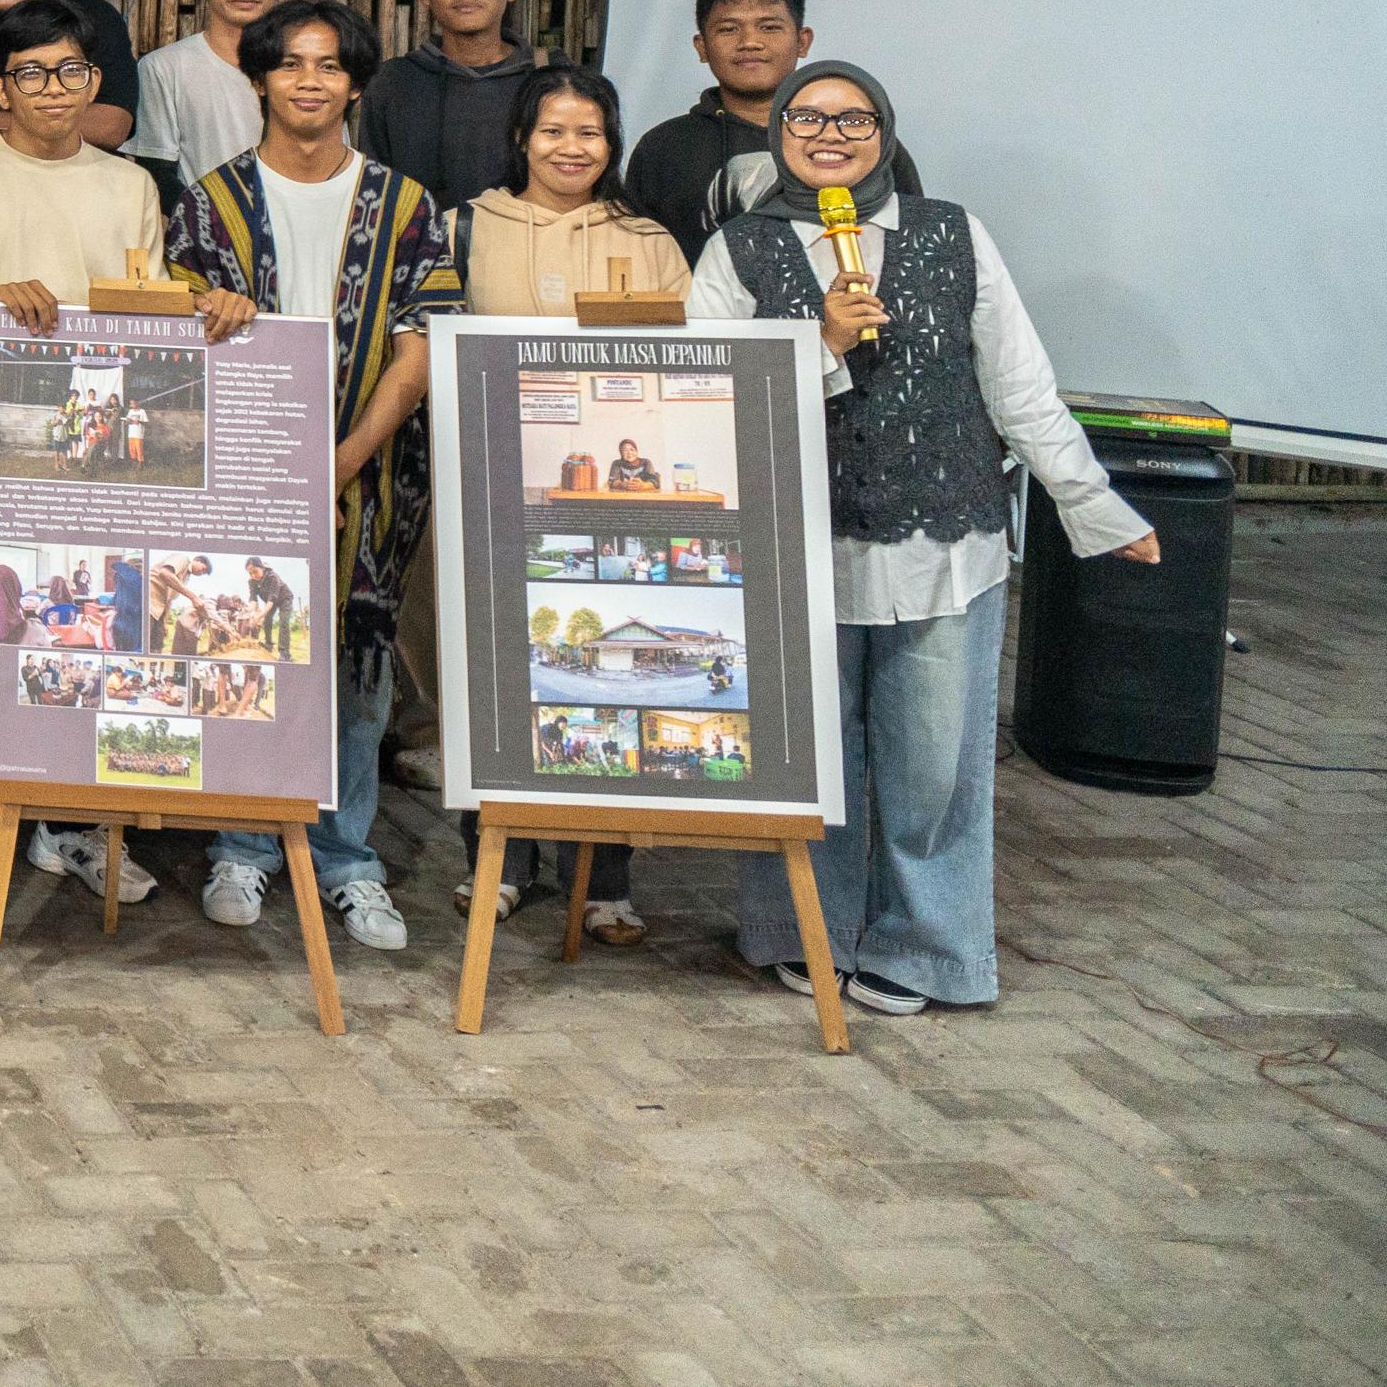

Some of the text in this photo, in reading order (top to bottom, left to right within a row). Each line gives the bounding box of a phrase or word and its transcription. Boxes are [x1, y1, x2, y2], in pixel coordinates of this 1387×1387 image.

[66, 316, 97, 333] KATA
[106, 318, 119, 335] DI
[127, 319, 171, 337] TANAH
[178, 322, 205, 339] SUN
[518, 342, 732, 366] JAMU UNTUK MASA DEPANMU
[1136, 459, 1181, 470] SONY
